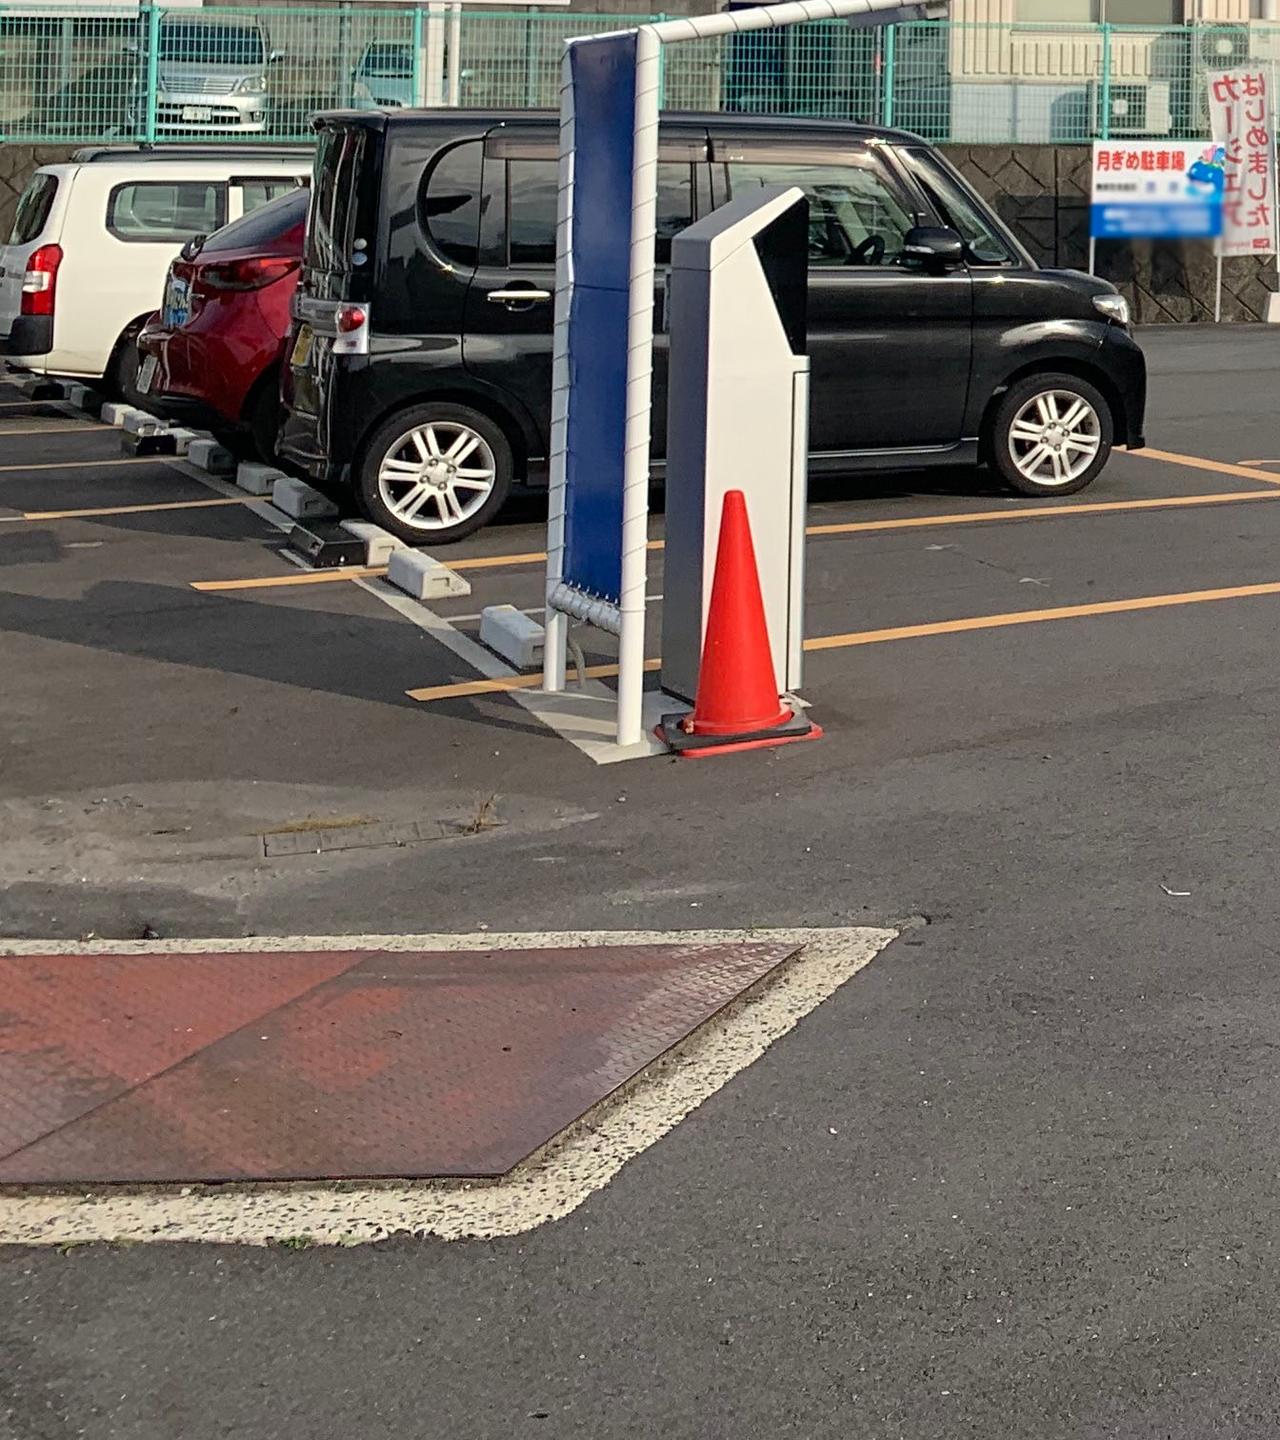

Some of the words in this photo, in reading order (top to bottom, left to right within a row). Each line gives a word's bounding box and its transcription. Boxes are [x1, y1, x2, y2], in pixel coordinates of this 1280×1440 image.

[1097, 150, 1185, 171] 月ぎめ駐車場
